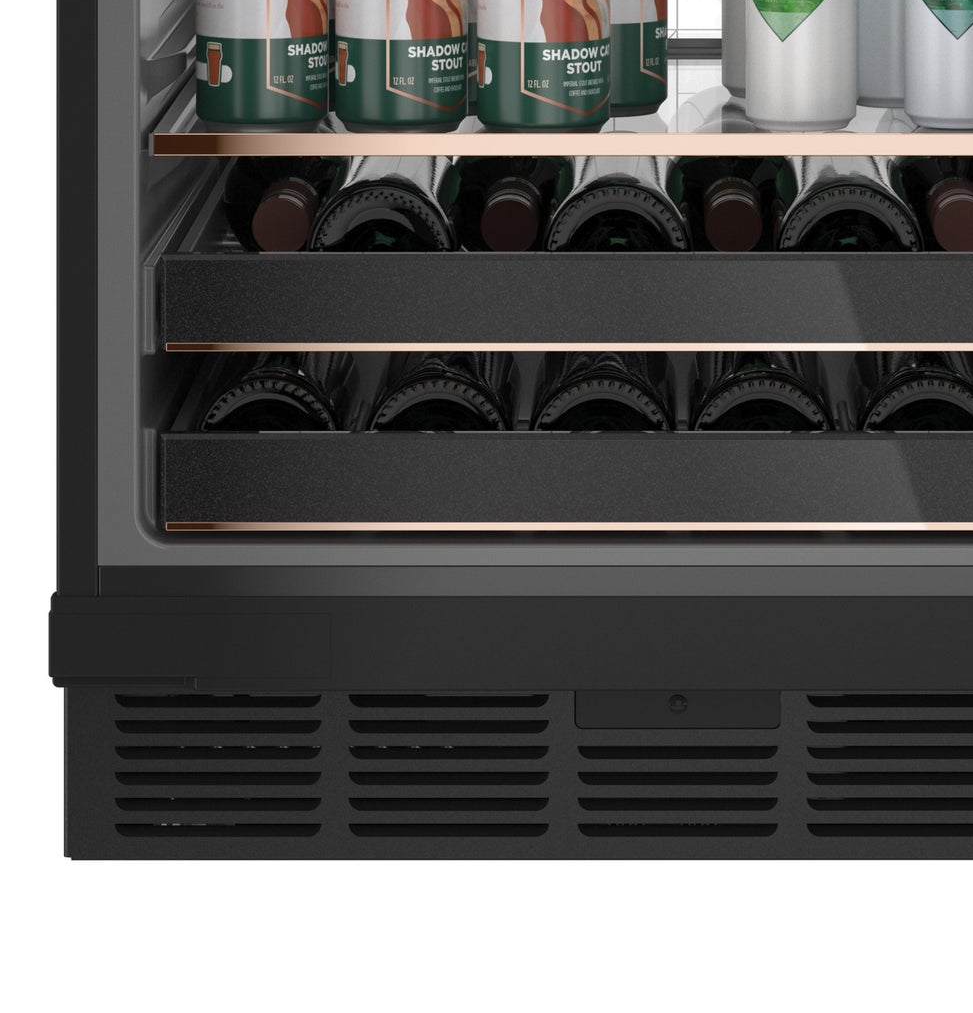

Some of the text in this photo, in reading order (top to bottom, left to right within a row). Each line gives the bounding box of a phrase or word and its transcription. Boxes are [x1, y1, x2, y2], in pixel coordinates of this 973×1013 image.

[408, 43, 460, 59] SHADOW
[542, 47, 598, 62] SHADOW
[307, 56, 329, 69] STOU
[431, 57, 463, 71] STOUT
[566, 60, 603, 75] STOUT
[393, 77, 399, 86] 12
[527, 79, 533, 89] 12
[541, 79, 549, 88] OZ
